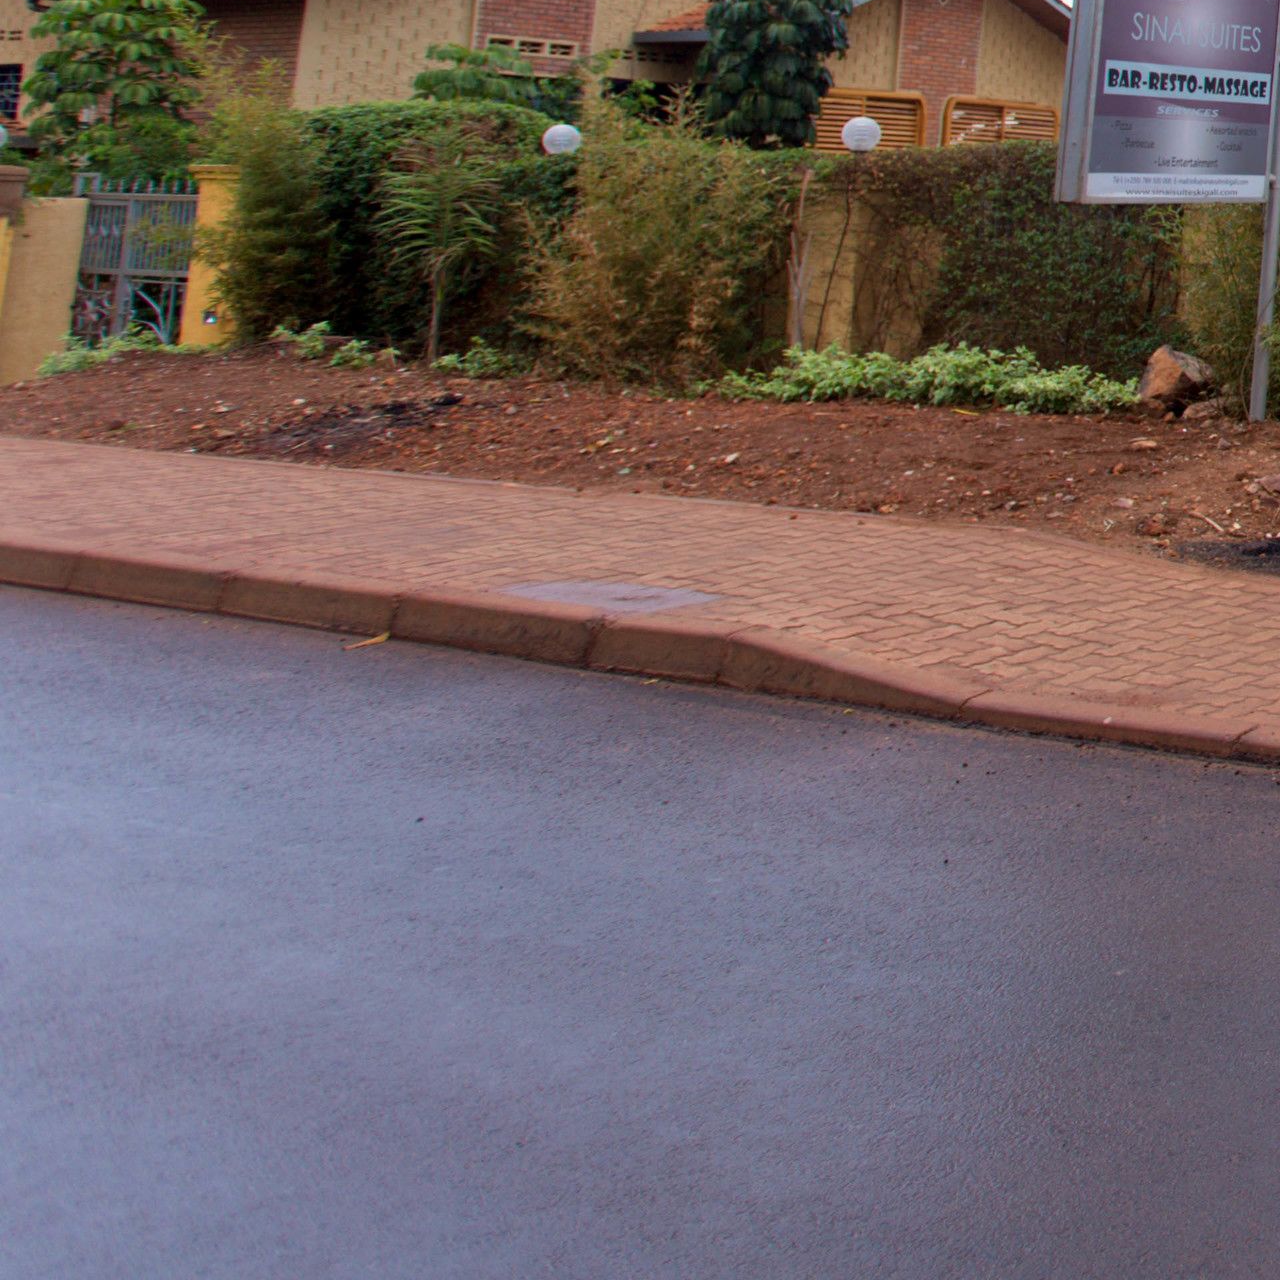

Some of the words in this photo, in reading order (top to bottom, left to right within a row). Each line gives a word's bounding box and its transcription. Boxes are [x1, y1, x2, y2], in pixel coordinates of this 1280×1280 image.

[1130, 11, 1191, 46] SINAI
[1199, 19, 1262, 53] SUITES
[1107, 67, 1267, 98] BAR-RESTO-MASSAGE
[1156, 104, 1220, 118] SERVICES
